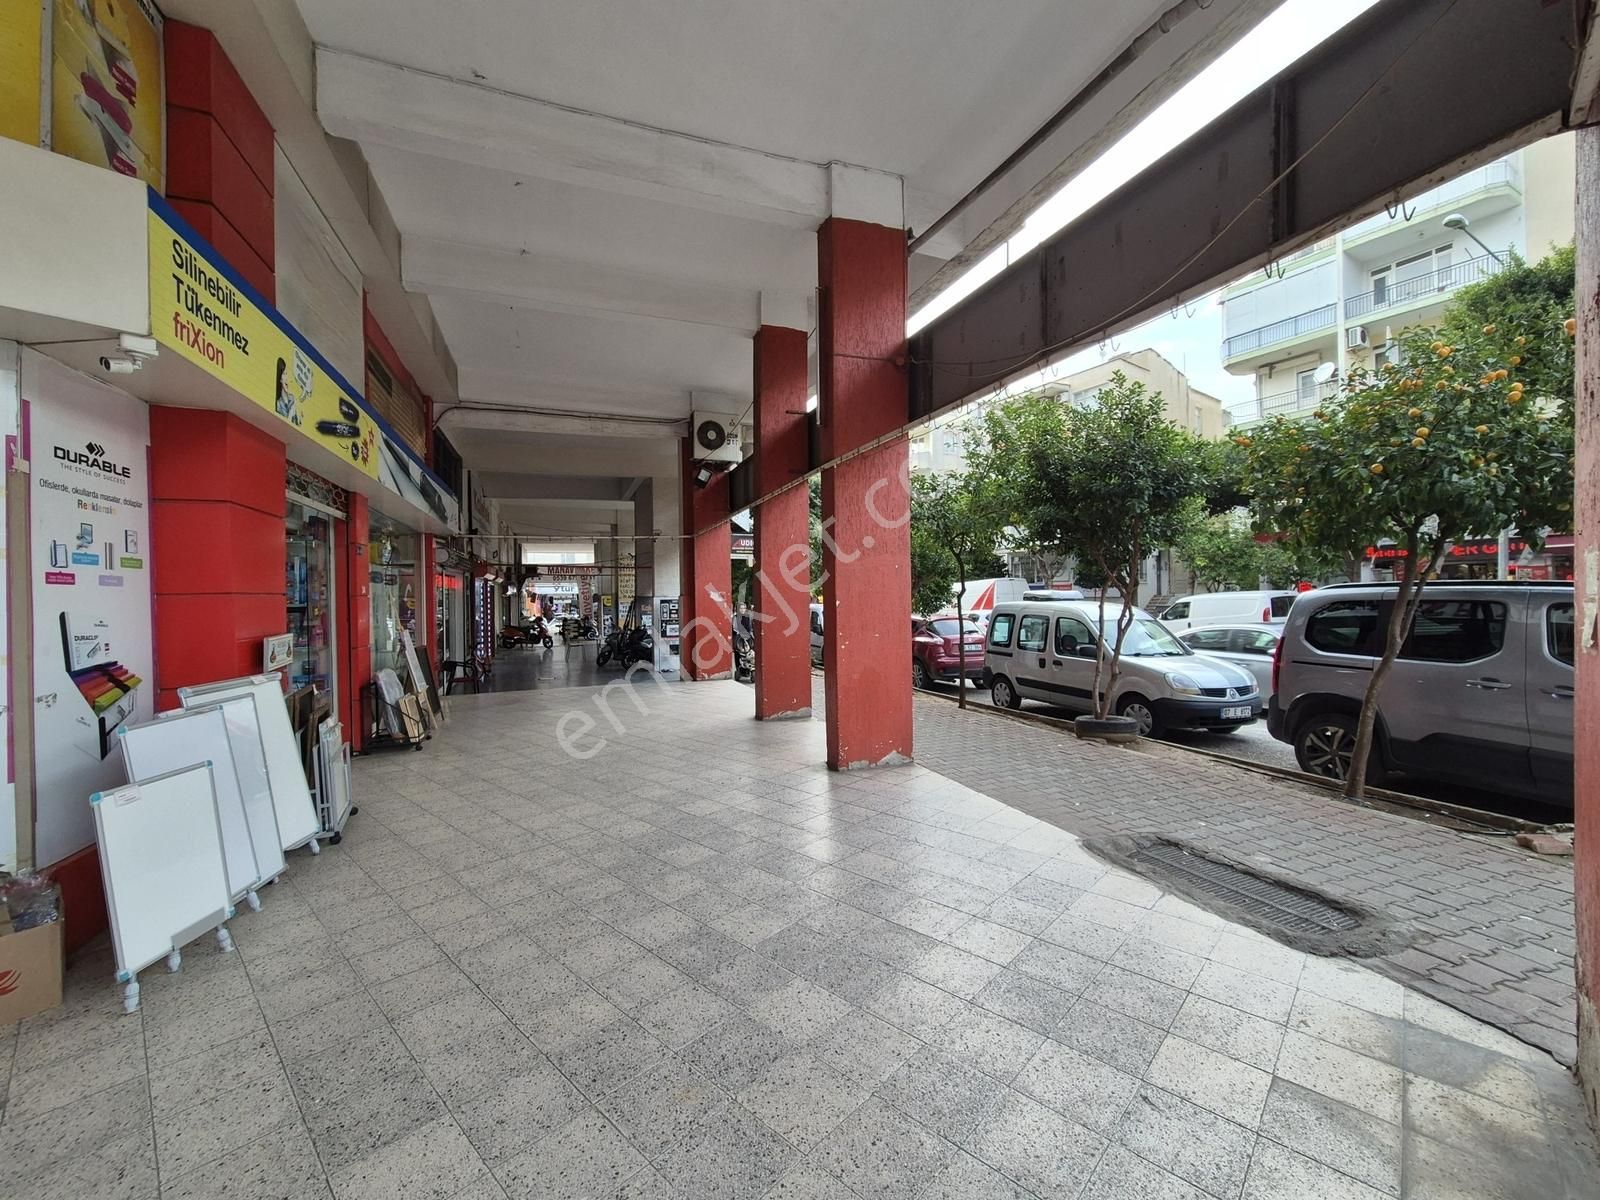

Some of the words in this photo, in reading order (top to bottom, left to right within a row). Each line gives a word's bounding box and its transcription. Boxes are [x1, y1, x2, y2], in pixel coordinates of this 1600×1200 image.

[172, 239, 242, 318] Silinebilir
[172, 274, 249, 356] Tükenmez
[172, 311, 225, 369] friXion
[53, 445, 131, 479] DURABLE
[60, 462, 73, 472] THE
[75, 466, 92, 477] STYLE
[94, 471, 102, 479] OF
[103, 474, 126, 485] SUCCESS
[39, 478, 71, 494] Ofislerde,
[71, 486, 99, 499] okullarda
[547, 566, 574, 574] MANAV
